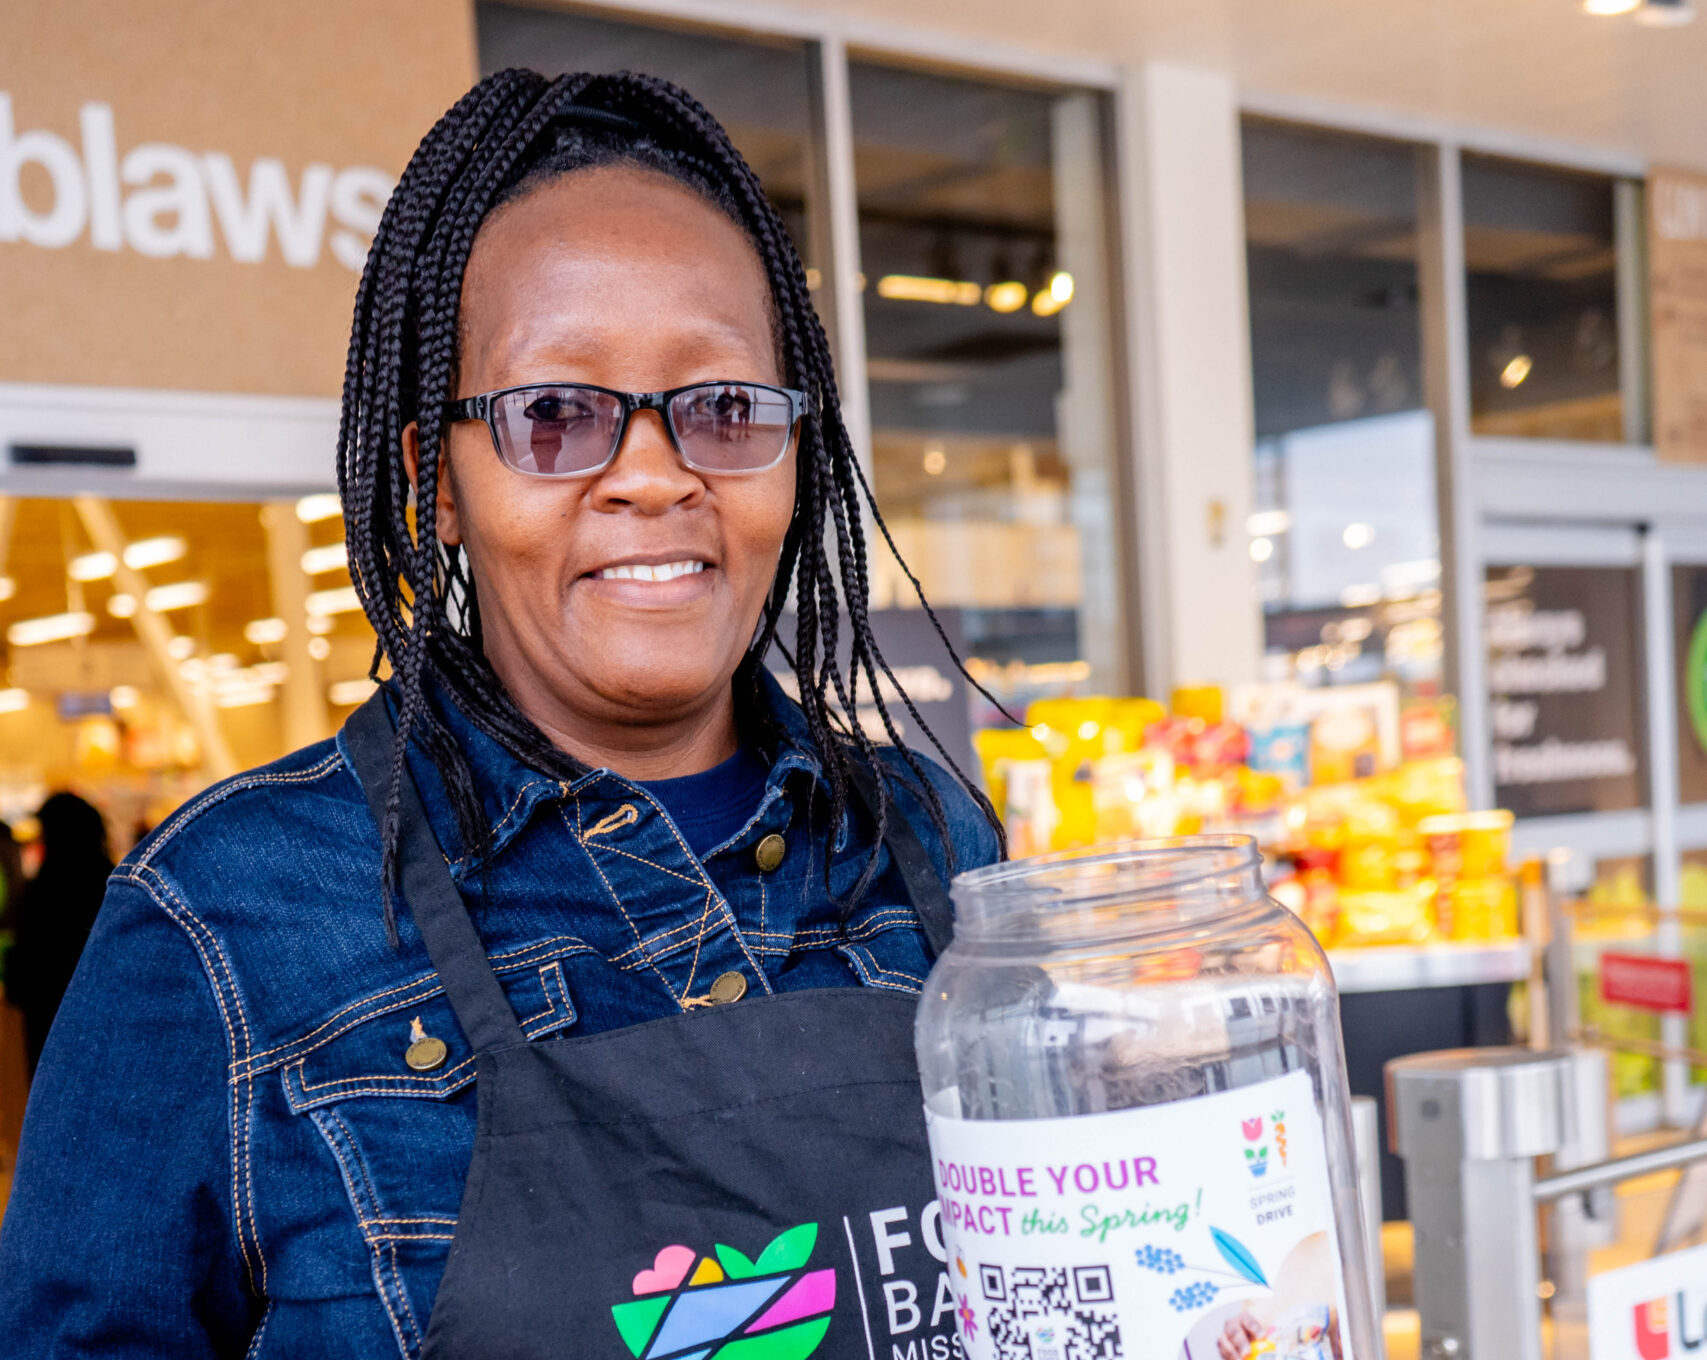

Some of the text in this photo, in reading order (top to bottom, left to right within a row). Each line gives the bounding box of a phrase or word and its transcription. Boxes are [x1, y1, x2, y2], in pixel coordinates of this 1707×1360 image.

[938, 1156, 1160, 1197] DOUBLE YOUR
[1250, 1186, 1295, 1210] SPRING
[939, 1187, 1202, 1243] MPACT this Spring!
[1256, 1204, 1294, 1226] DRIVE
